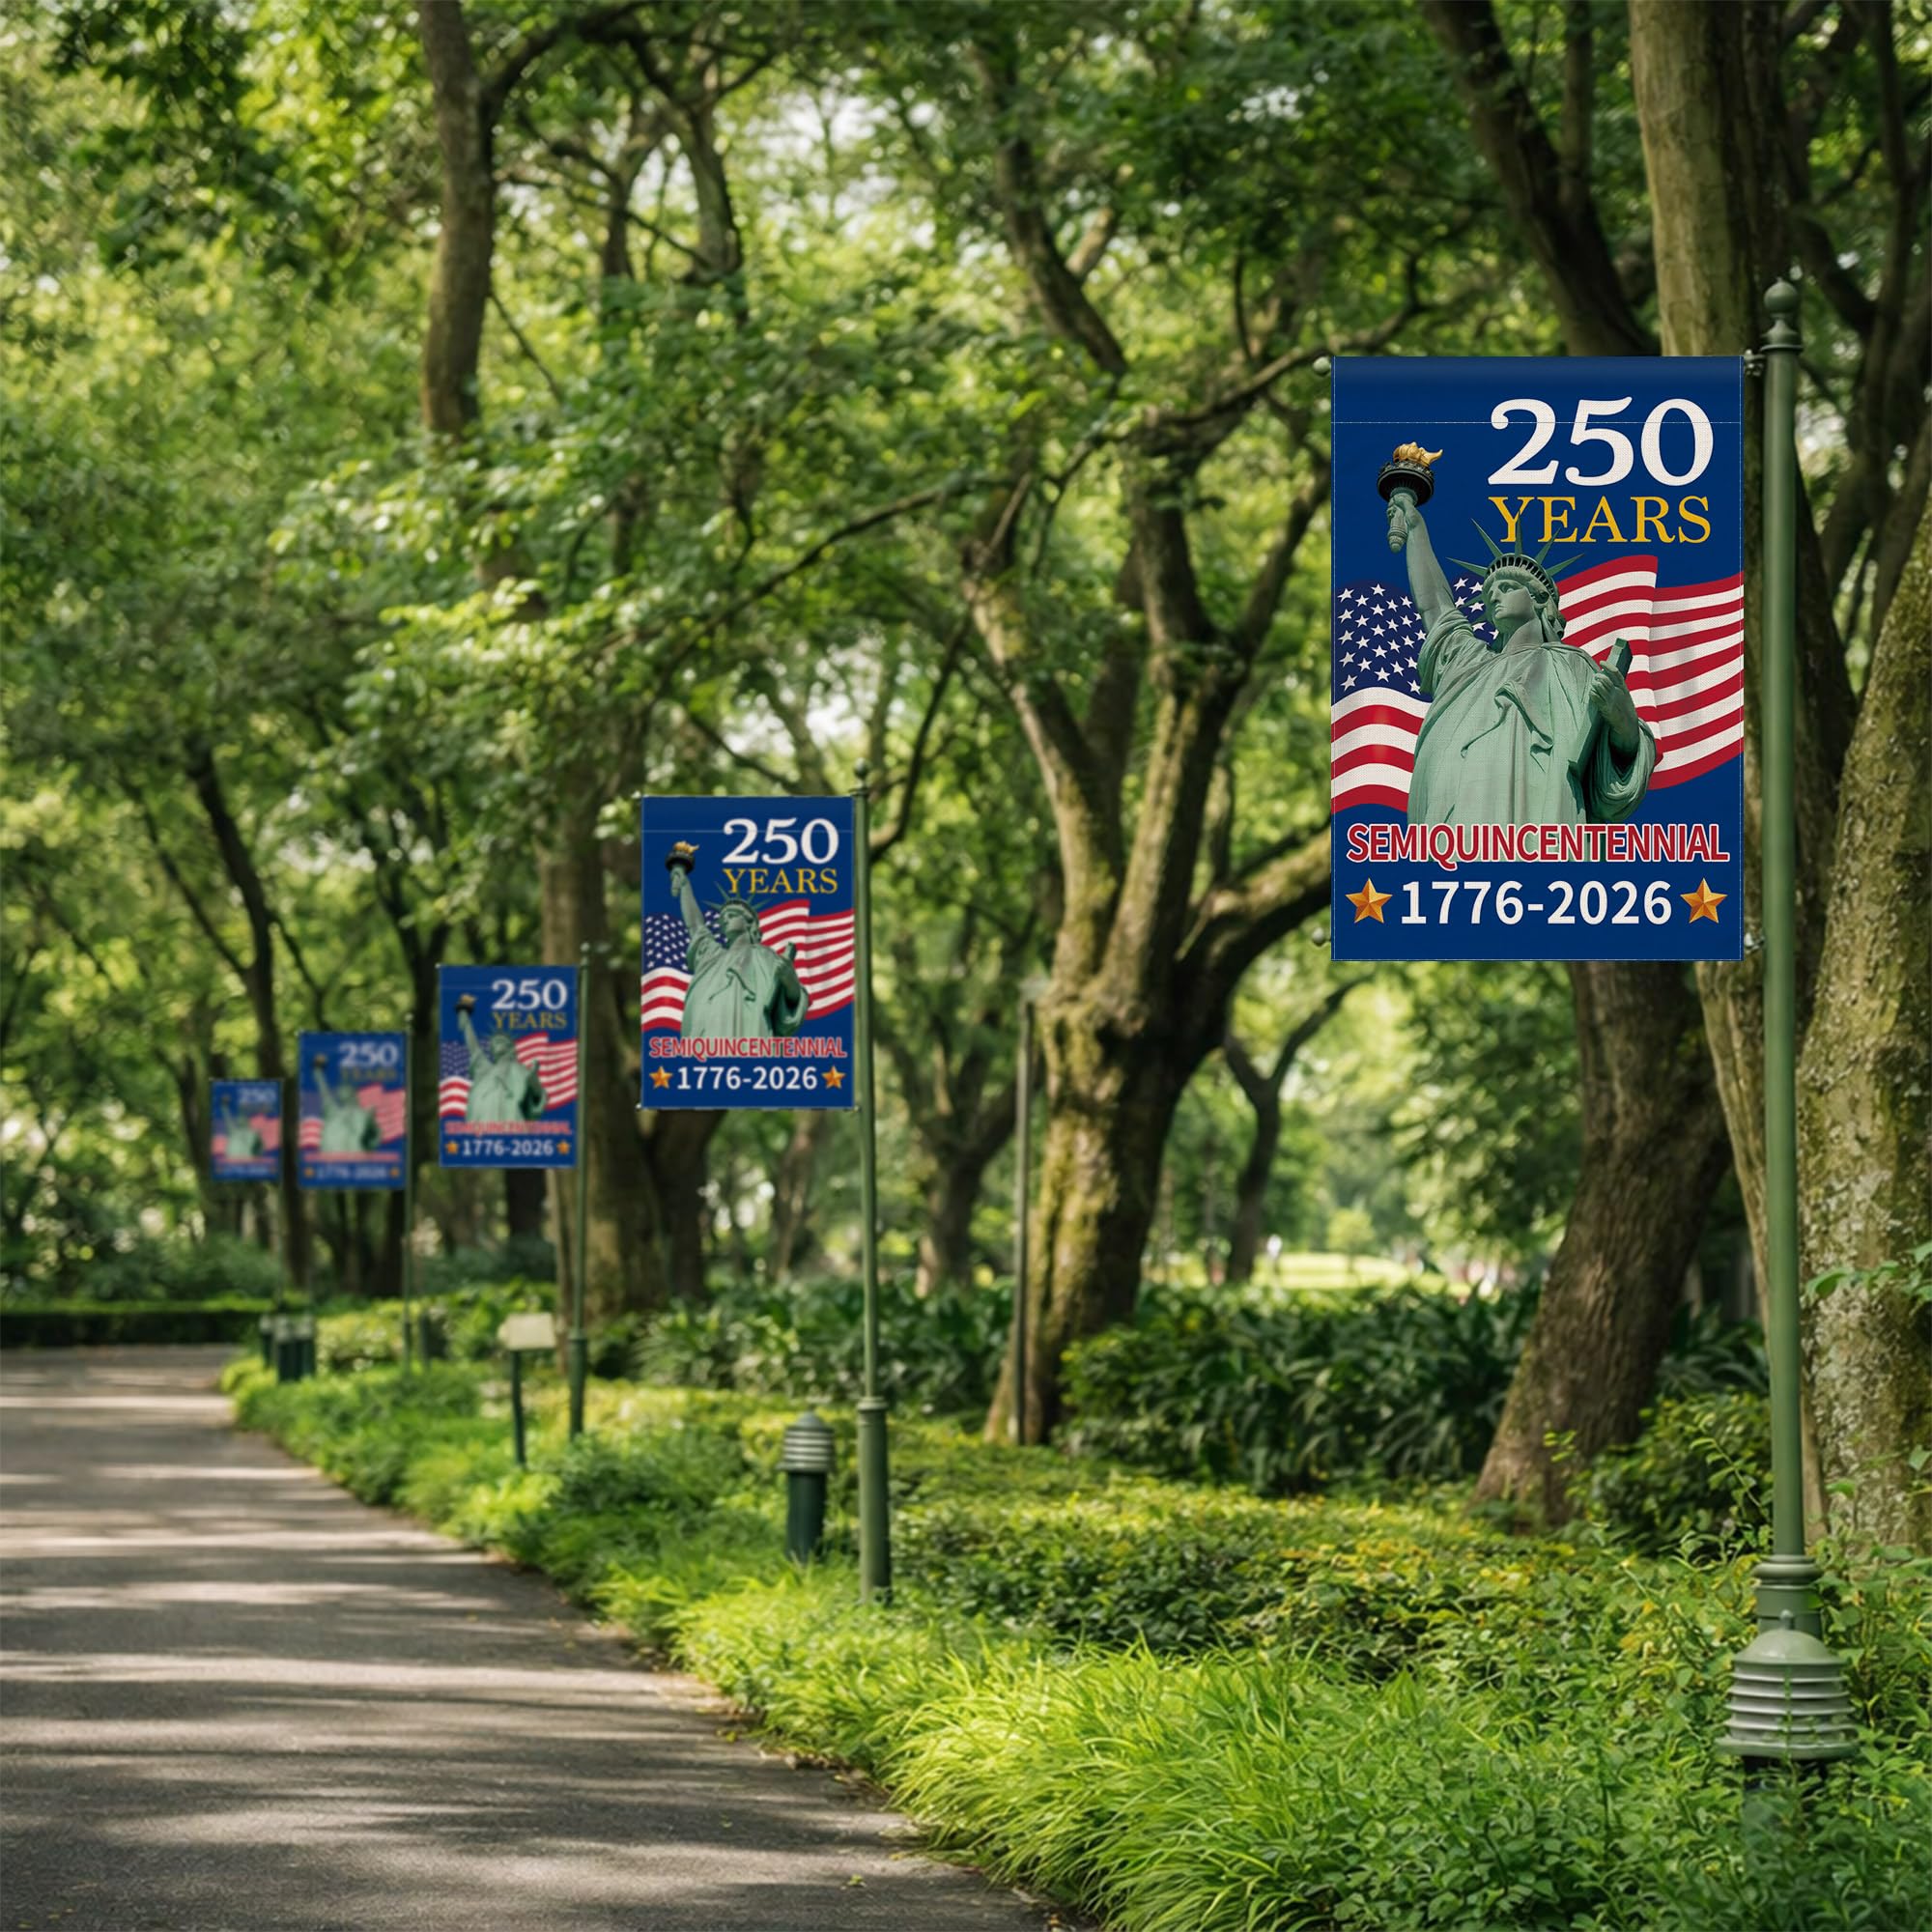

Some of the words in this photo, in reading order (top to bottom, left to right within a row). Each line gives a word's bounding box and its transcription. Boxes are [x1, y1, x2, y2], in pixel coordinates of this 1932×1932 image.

[1489, 397, 1714, 487] 250
[1490, 497, 1712, 544] YEARS
[723, 818, 839, 864] 250
[1347, 823, 1729, 871] SEMIQUINCENTENNIAL
[723, 868, 838, 894] YEARS
[1400, 881, 1672, 925] 1776-2026
[492, 980, 567, 1009] 250
[492, 1012, 566, 1029] YEARS
[340, 1041, 398, 1066] 250
[649, 1037, 847, 1062] SEMIQUINCENTENNIAL
[677, 1066, 817, 1090] 1776-2026
[463, 1140, 554, 1155] 1776-2026
